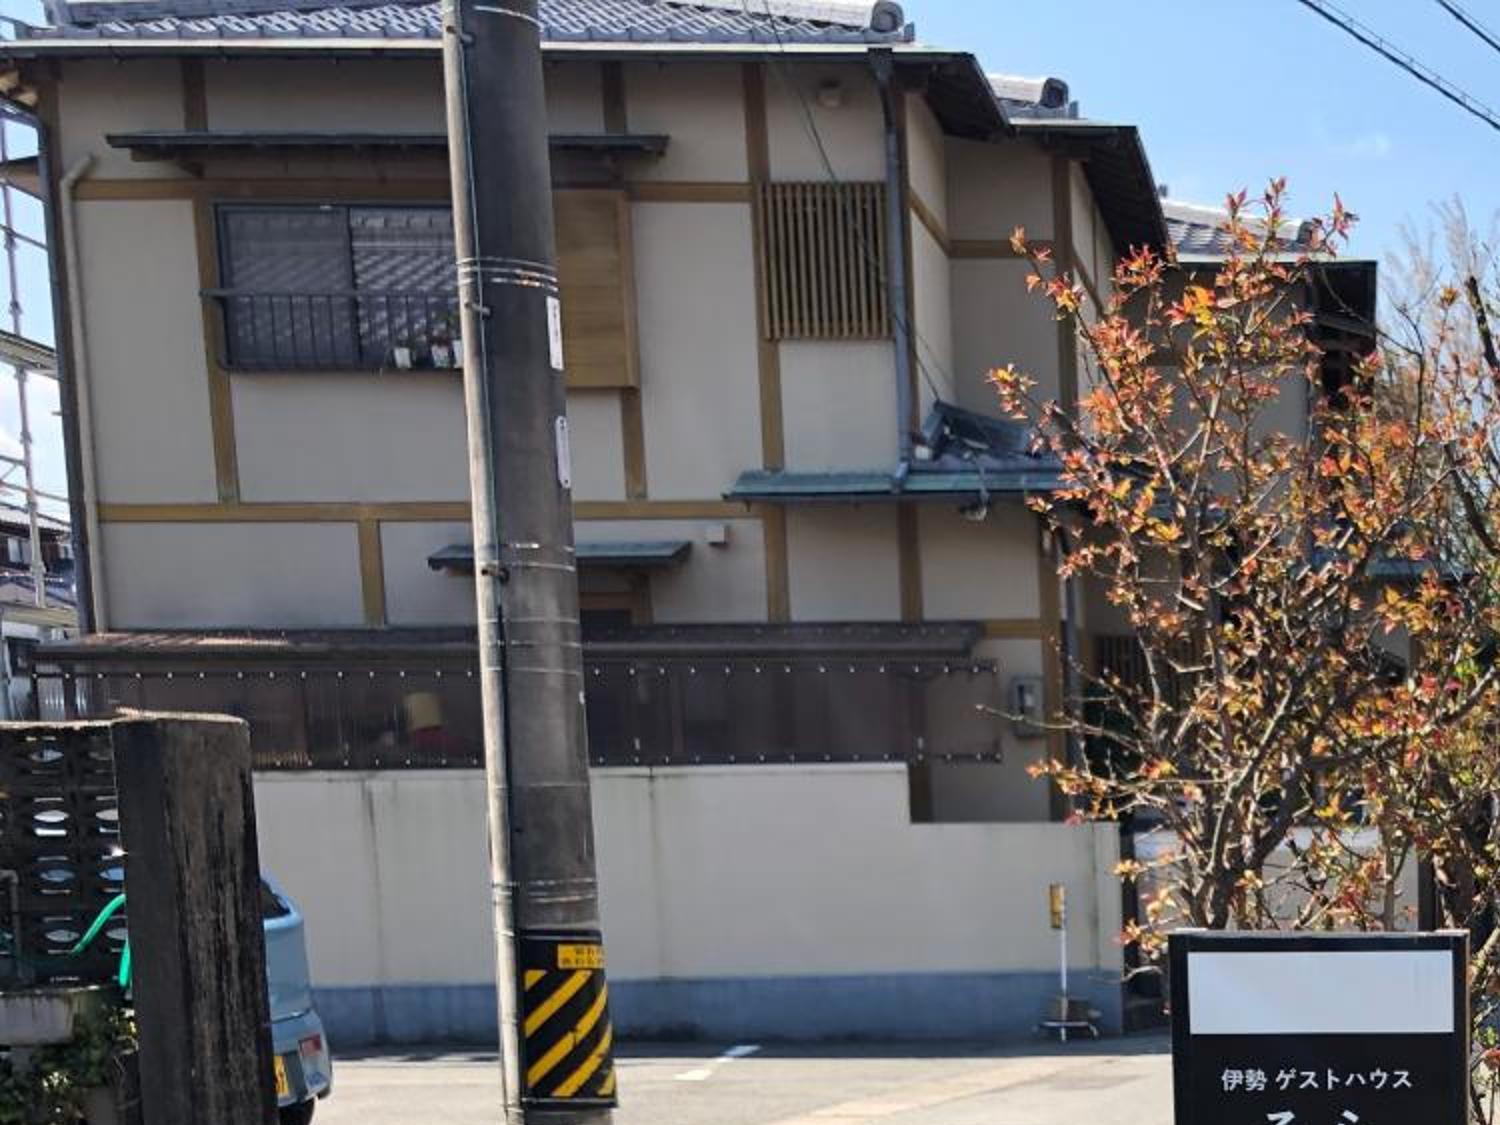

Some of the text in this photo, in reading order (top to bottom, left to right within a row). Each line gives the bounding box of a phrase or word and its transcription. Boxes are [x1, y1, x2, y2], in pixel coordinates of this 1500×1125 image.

[1221, 1068, 1412, 1091] 伊勢 ゲストハウス
